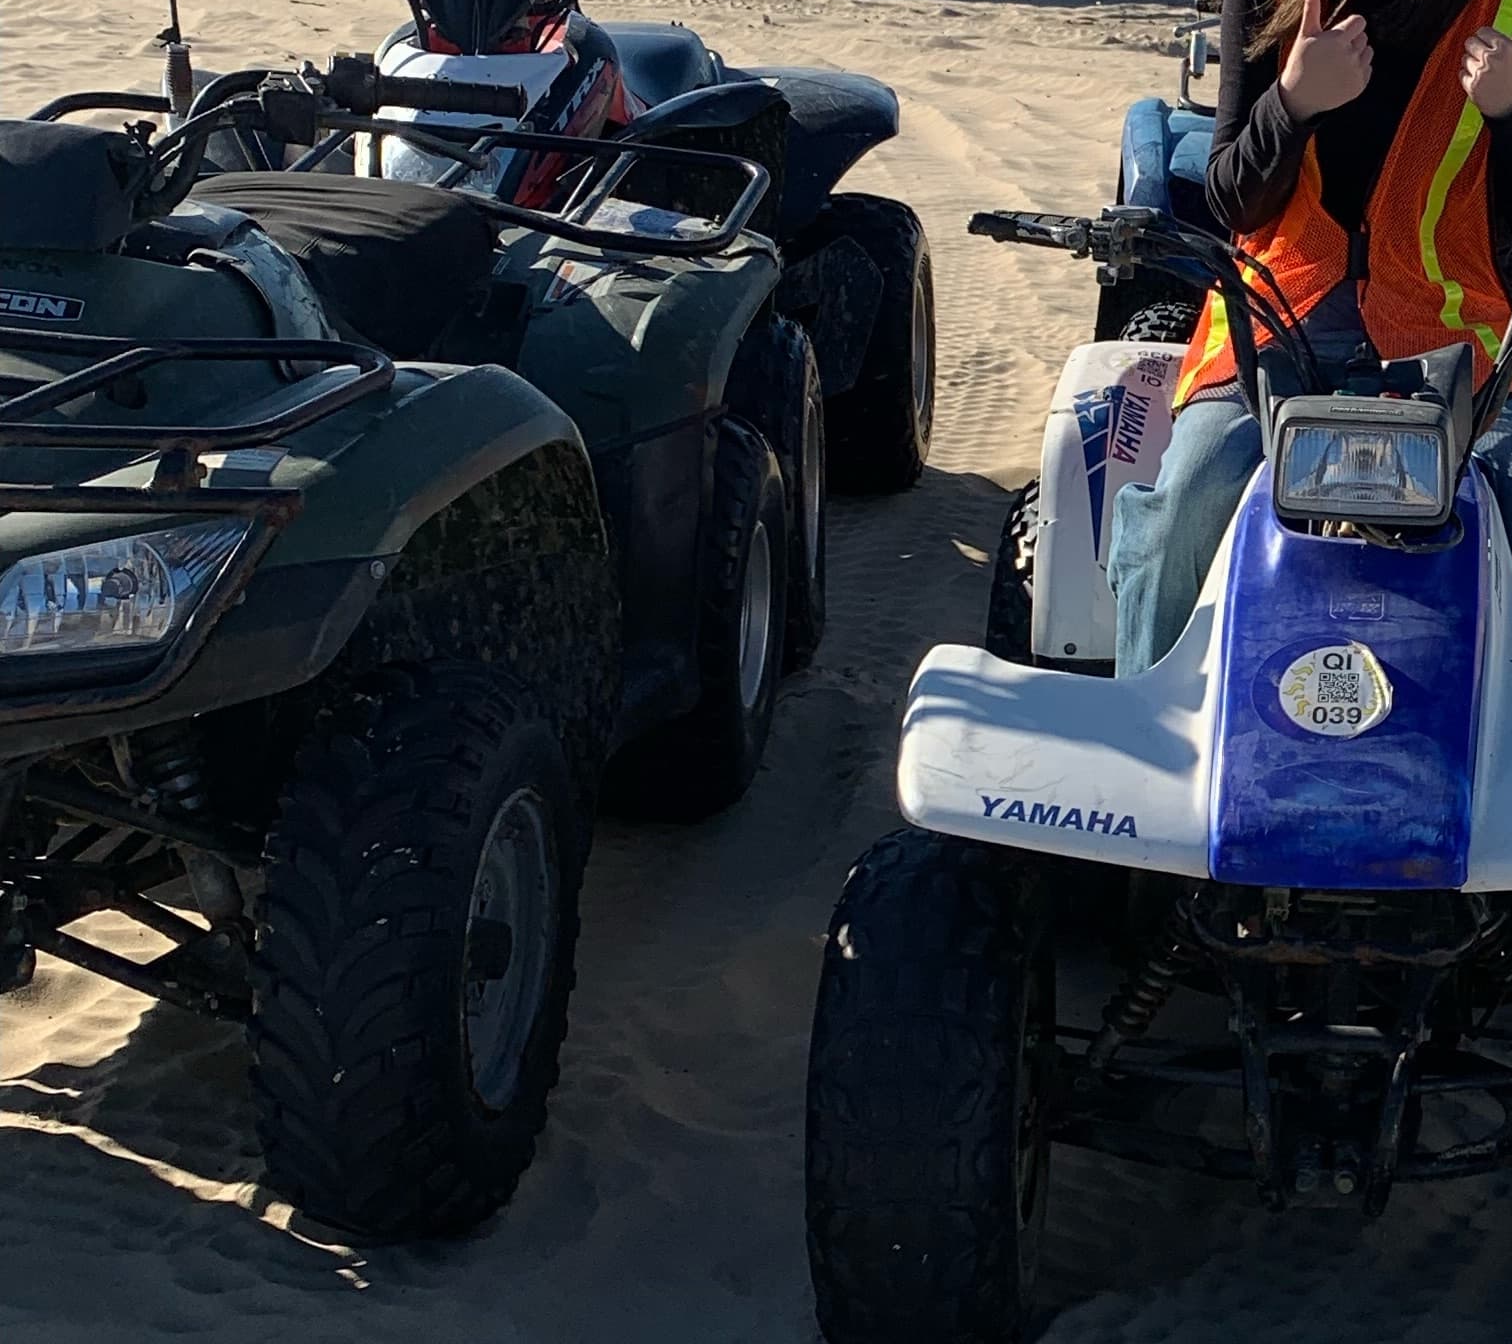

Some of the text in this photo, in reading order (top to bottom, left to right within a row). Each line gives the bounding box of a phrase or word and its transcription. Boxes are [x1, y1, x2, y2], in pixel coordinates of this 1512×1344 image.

[1112, 391, 1151, 465] YAMAHA
[1323, 653, 1352, 670] QI
[1312, 706, 1362, 725] 039
[981, 795, 1137, 838] YAMAHA
